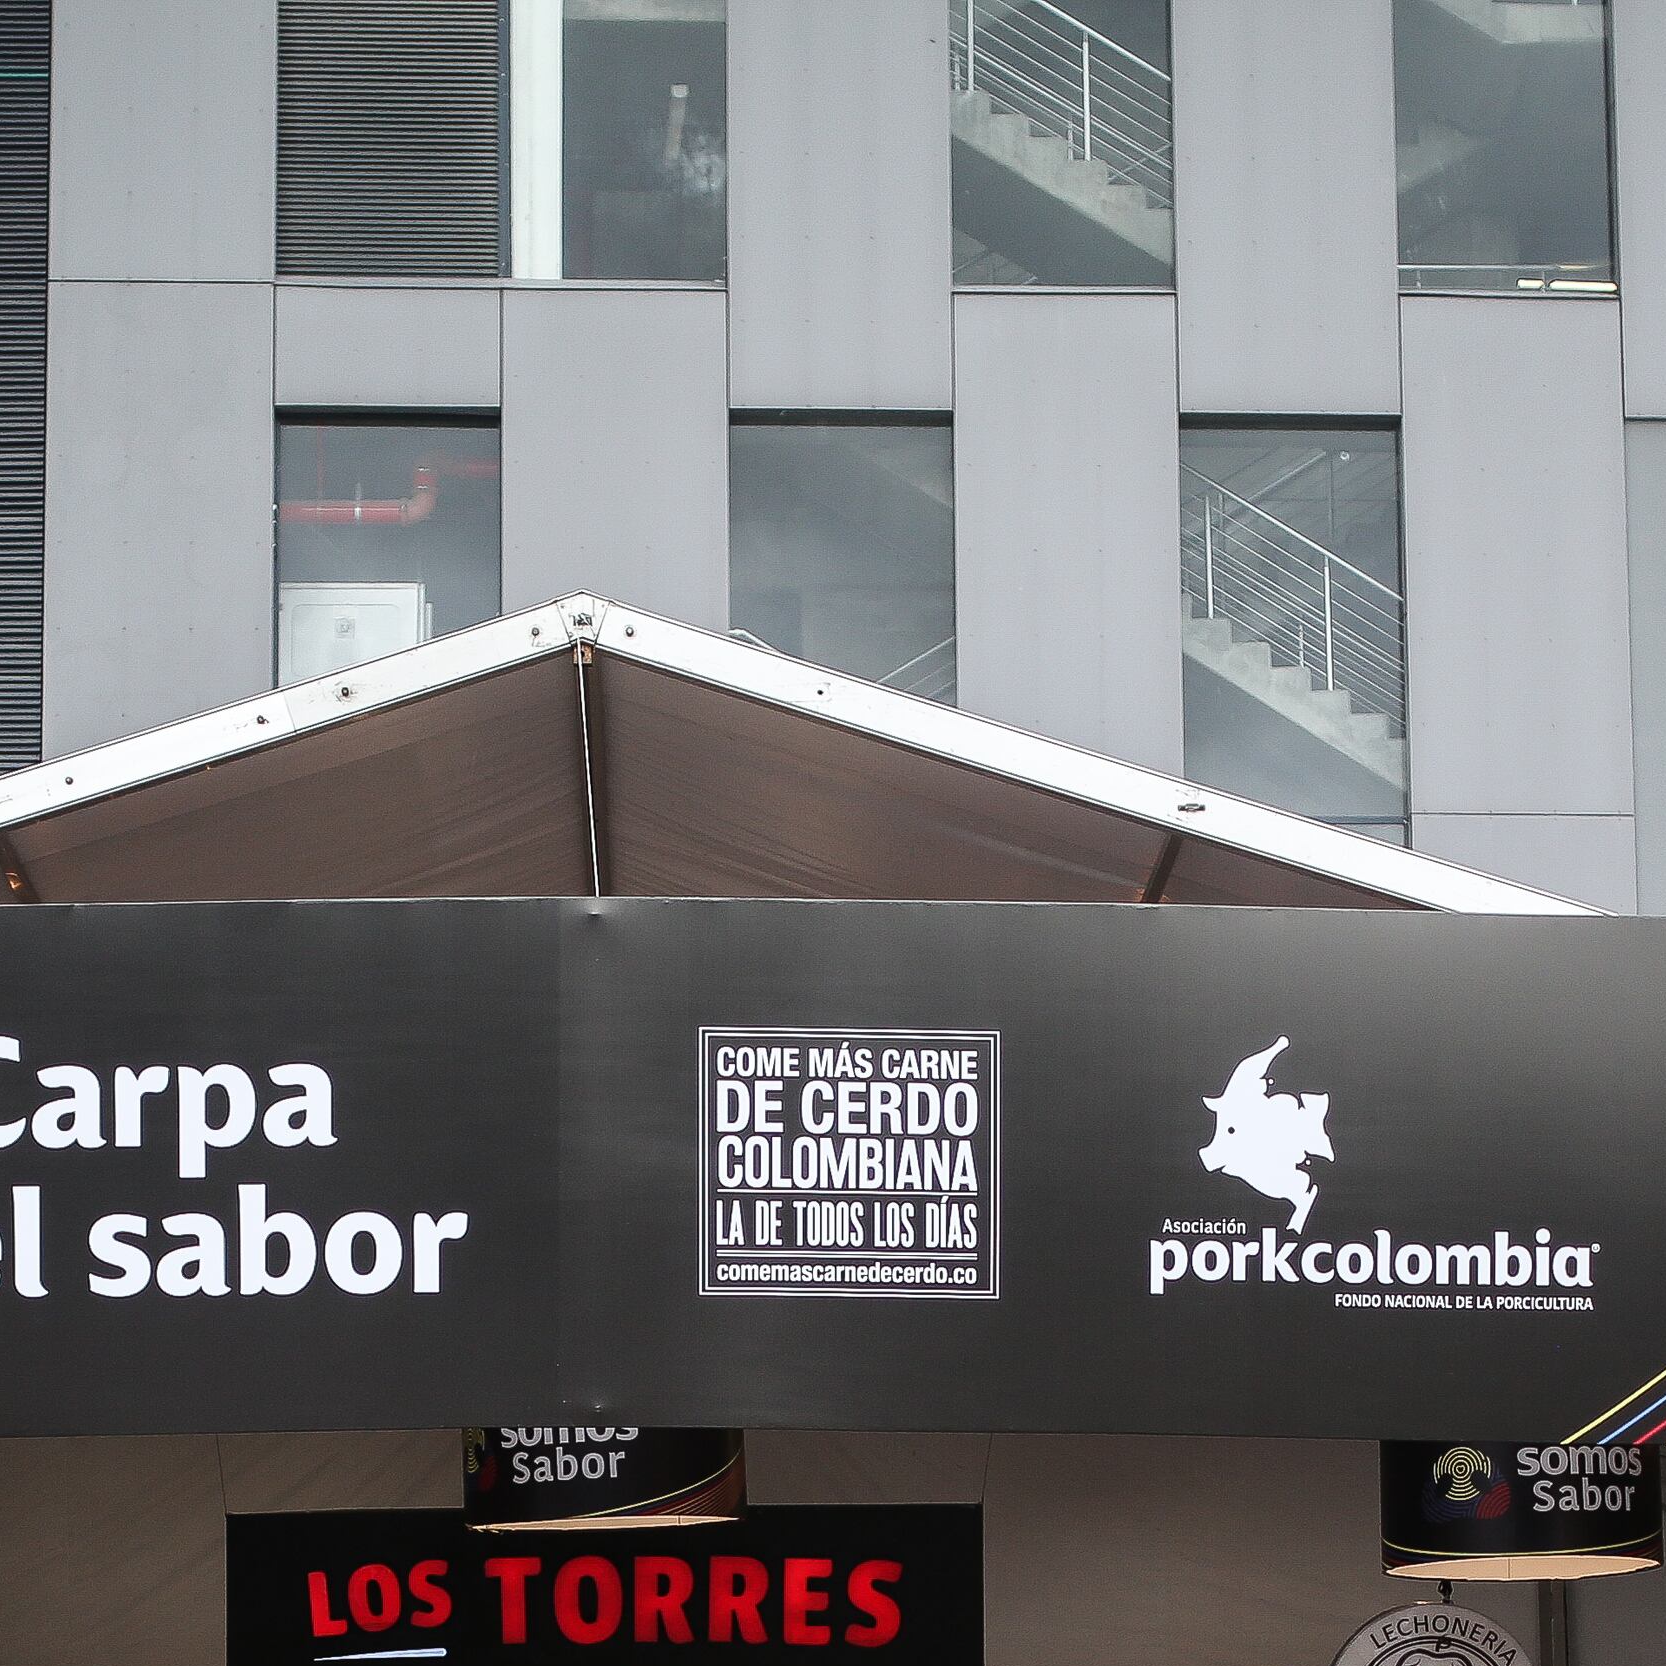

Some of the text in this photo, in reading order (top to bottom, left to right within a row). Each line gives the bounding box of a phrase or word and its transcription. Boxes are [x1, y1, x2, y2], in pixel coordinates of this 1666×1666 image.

[716, 1041, 978, 1080] COME MÁS CARNE
[716, 1080, 979, 1136] DE CERDO
[717, 1136, 978, 1192] COLOMBIANA
[87, 1184, 469, 1296] sabor
[716, 1195, 977, 1249] LA DE TODOS LOS DÍAS
[1162, 1217, 1246, 1235] Asociación
[717, 1262, 977, 1285] comemascarnedecerdo.co
[1150, 1228, 1594, 1294] porkcolombia
[1335, 1293, 1593, 1311] FONDO NACIONAL DE LA PORCICULTURA
[513, 1447, 625, 1484] Sabor
[1517, 1445, 1642, 1476] somos
[1533, 1480, 1635, 1513] Sabor
[307, 1556, 904, 1648] LOS TORRES
